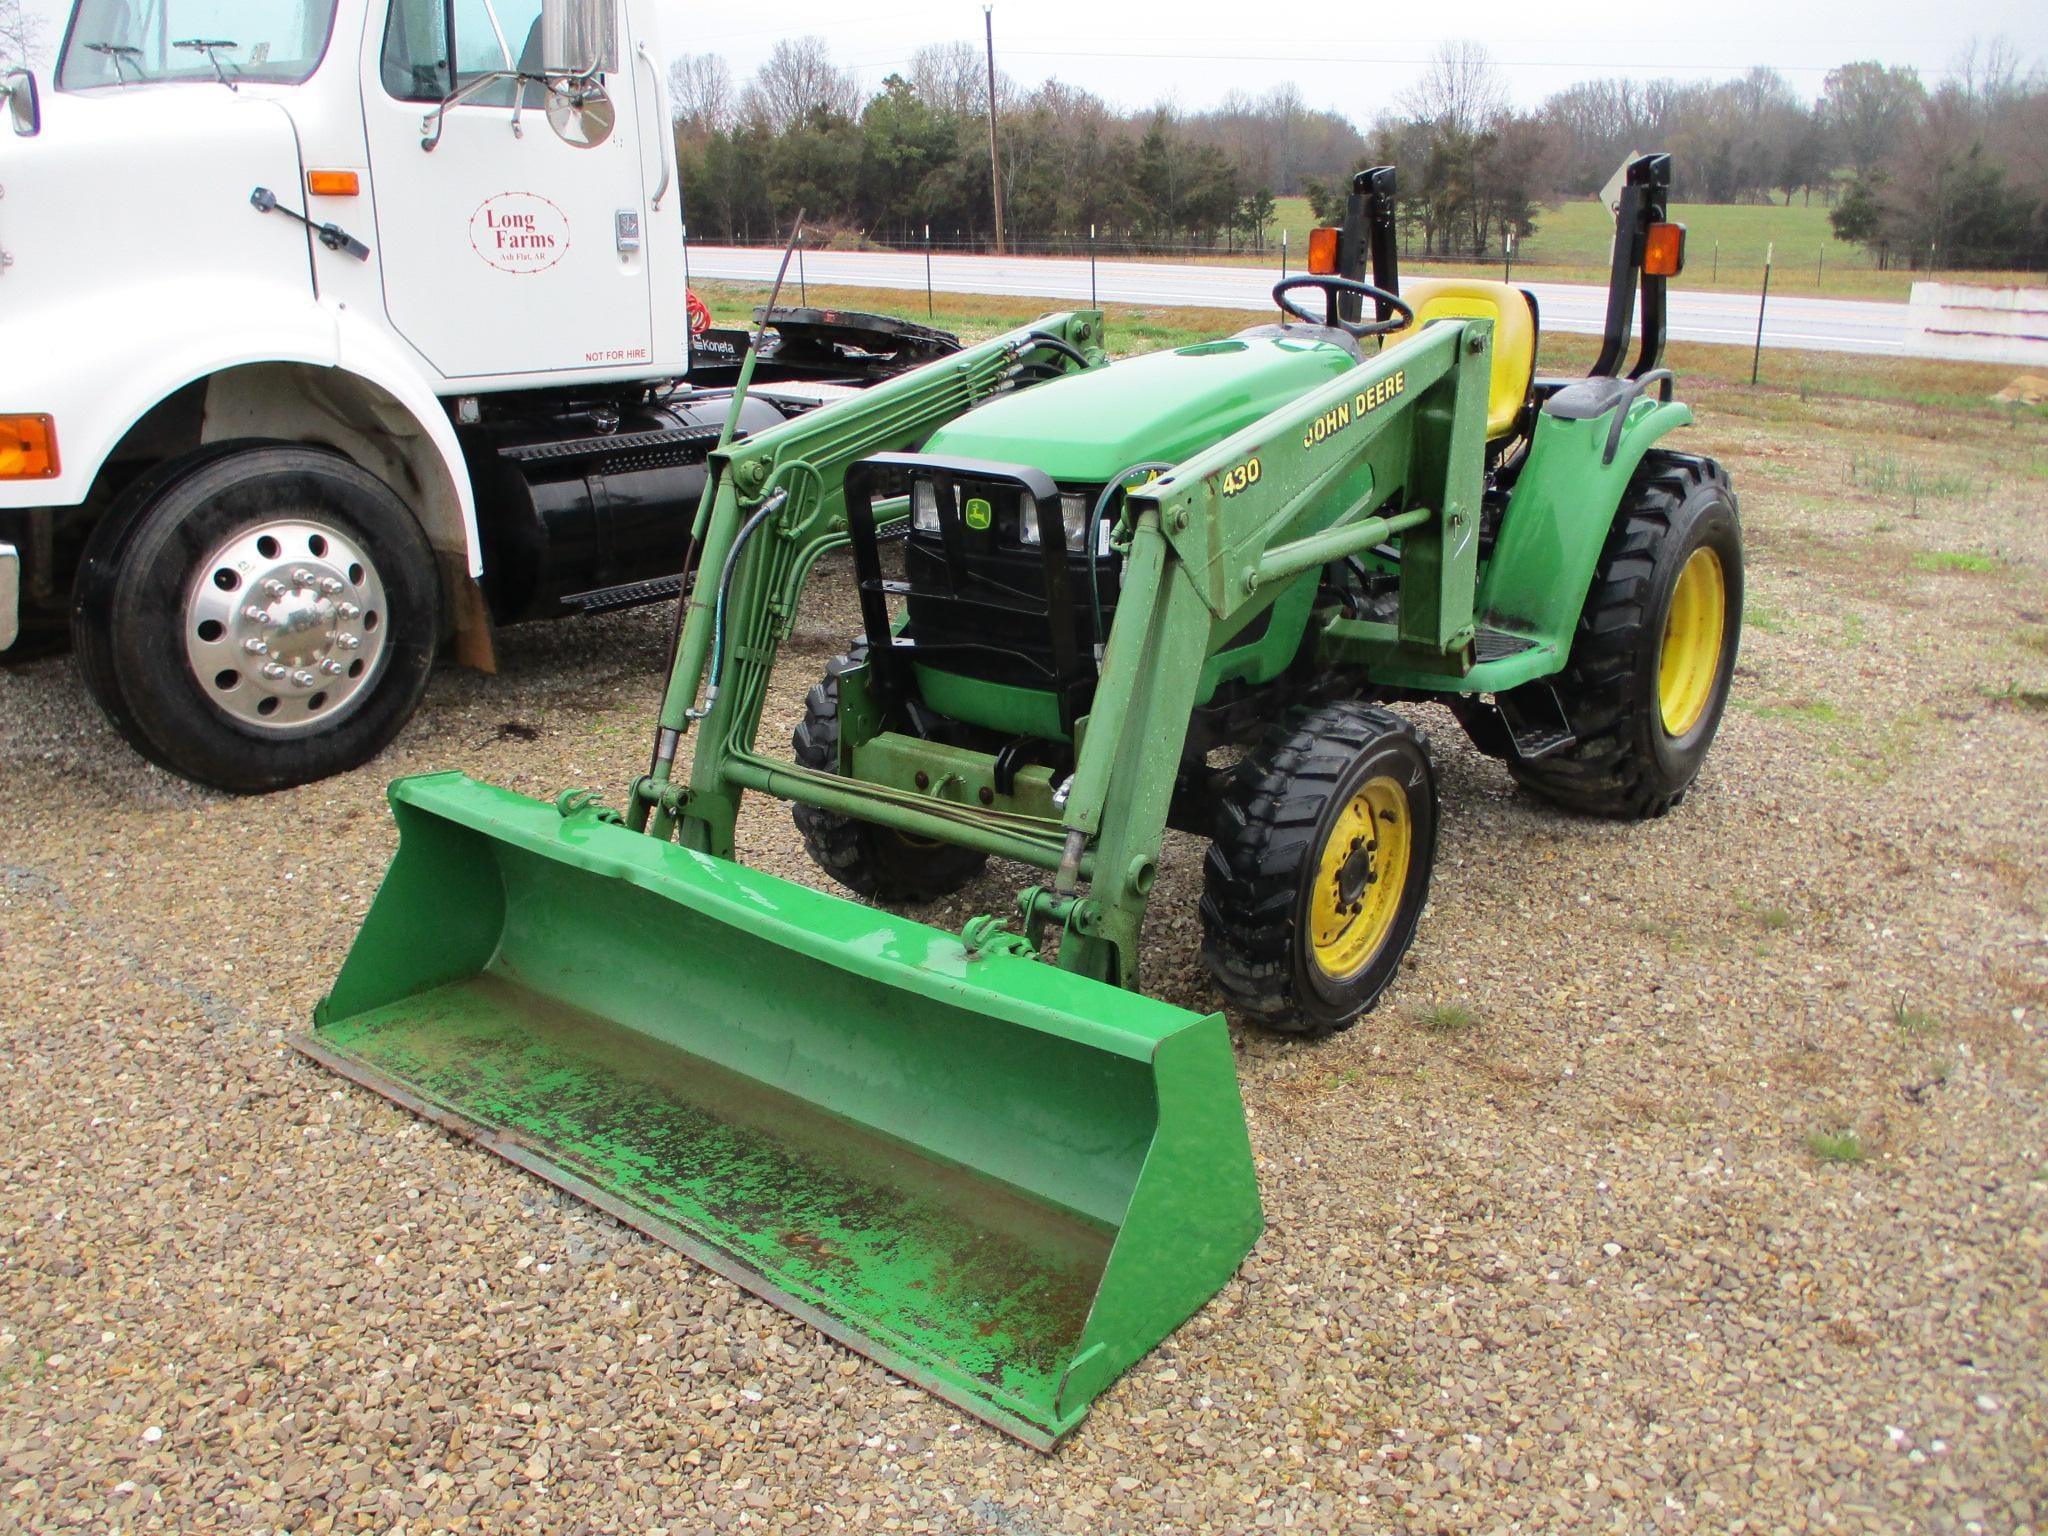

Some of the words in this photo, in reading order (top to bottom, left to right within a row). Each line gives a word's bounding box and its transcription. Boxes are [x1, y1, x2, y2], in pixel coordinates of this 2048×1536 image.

[487, 209, 536, 233] Long
[494, 229, 555, 248] Farms
[501, 253, 514, 261] Ash
[534, 252, 546, 261] AR
[585, 352, 604, 361] NOT
[606, 350, 624, 360] FOR
[626, 348, 646, 358] HIRE
[702, 339, 735, 353] Koneta
[1303, 401, 1350, 450] JOHN
[1355, 369, 1406, 420] DEERE
[1223, 457, 1262, 498] 430
